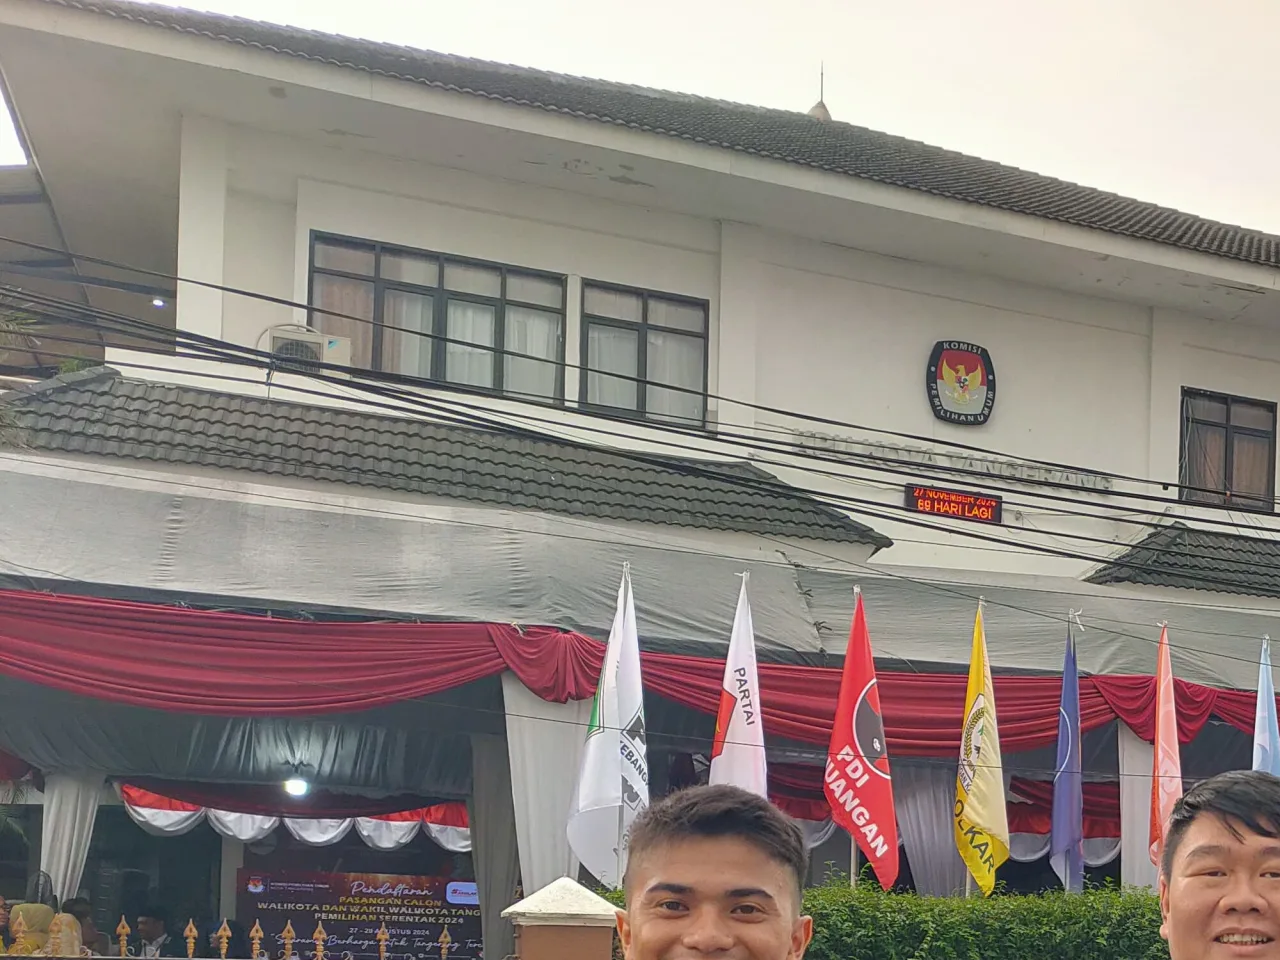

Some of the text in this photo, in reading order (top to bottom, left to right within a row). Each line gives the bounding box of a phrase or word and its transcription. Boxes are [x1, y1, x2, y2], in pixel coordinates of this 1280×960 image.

[943, 342, 982, 355] KOMISI
[931, 383, 994, 422] PEMILIHAN UMUM
[926, 489, 974, 504] NOVEMBER
[934, 500, 962, 515] HARI
[965, 504, 992, 519] LAGI
[734, 667, 755, 726] PARTAI
[836, 745, 870, 788] PDI
[351, 881, 433, 896] Pendaftaran
[257, 902, 320, 912] WALIKOTA
[322, 904, 346, 912] DAN
[349, 905, 387, 914] WAKIL
[389, 906, 447, 915] WALIKOTA
[340, 896, 442, 907] PASANGAN CALON
[314, 912, 464, 925] PEMILIHAN SERENTAK 2024
[326, 935, 377, 949] Berharga
